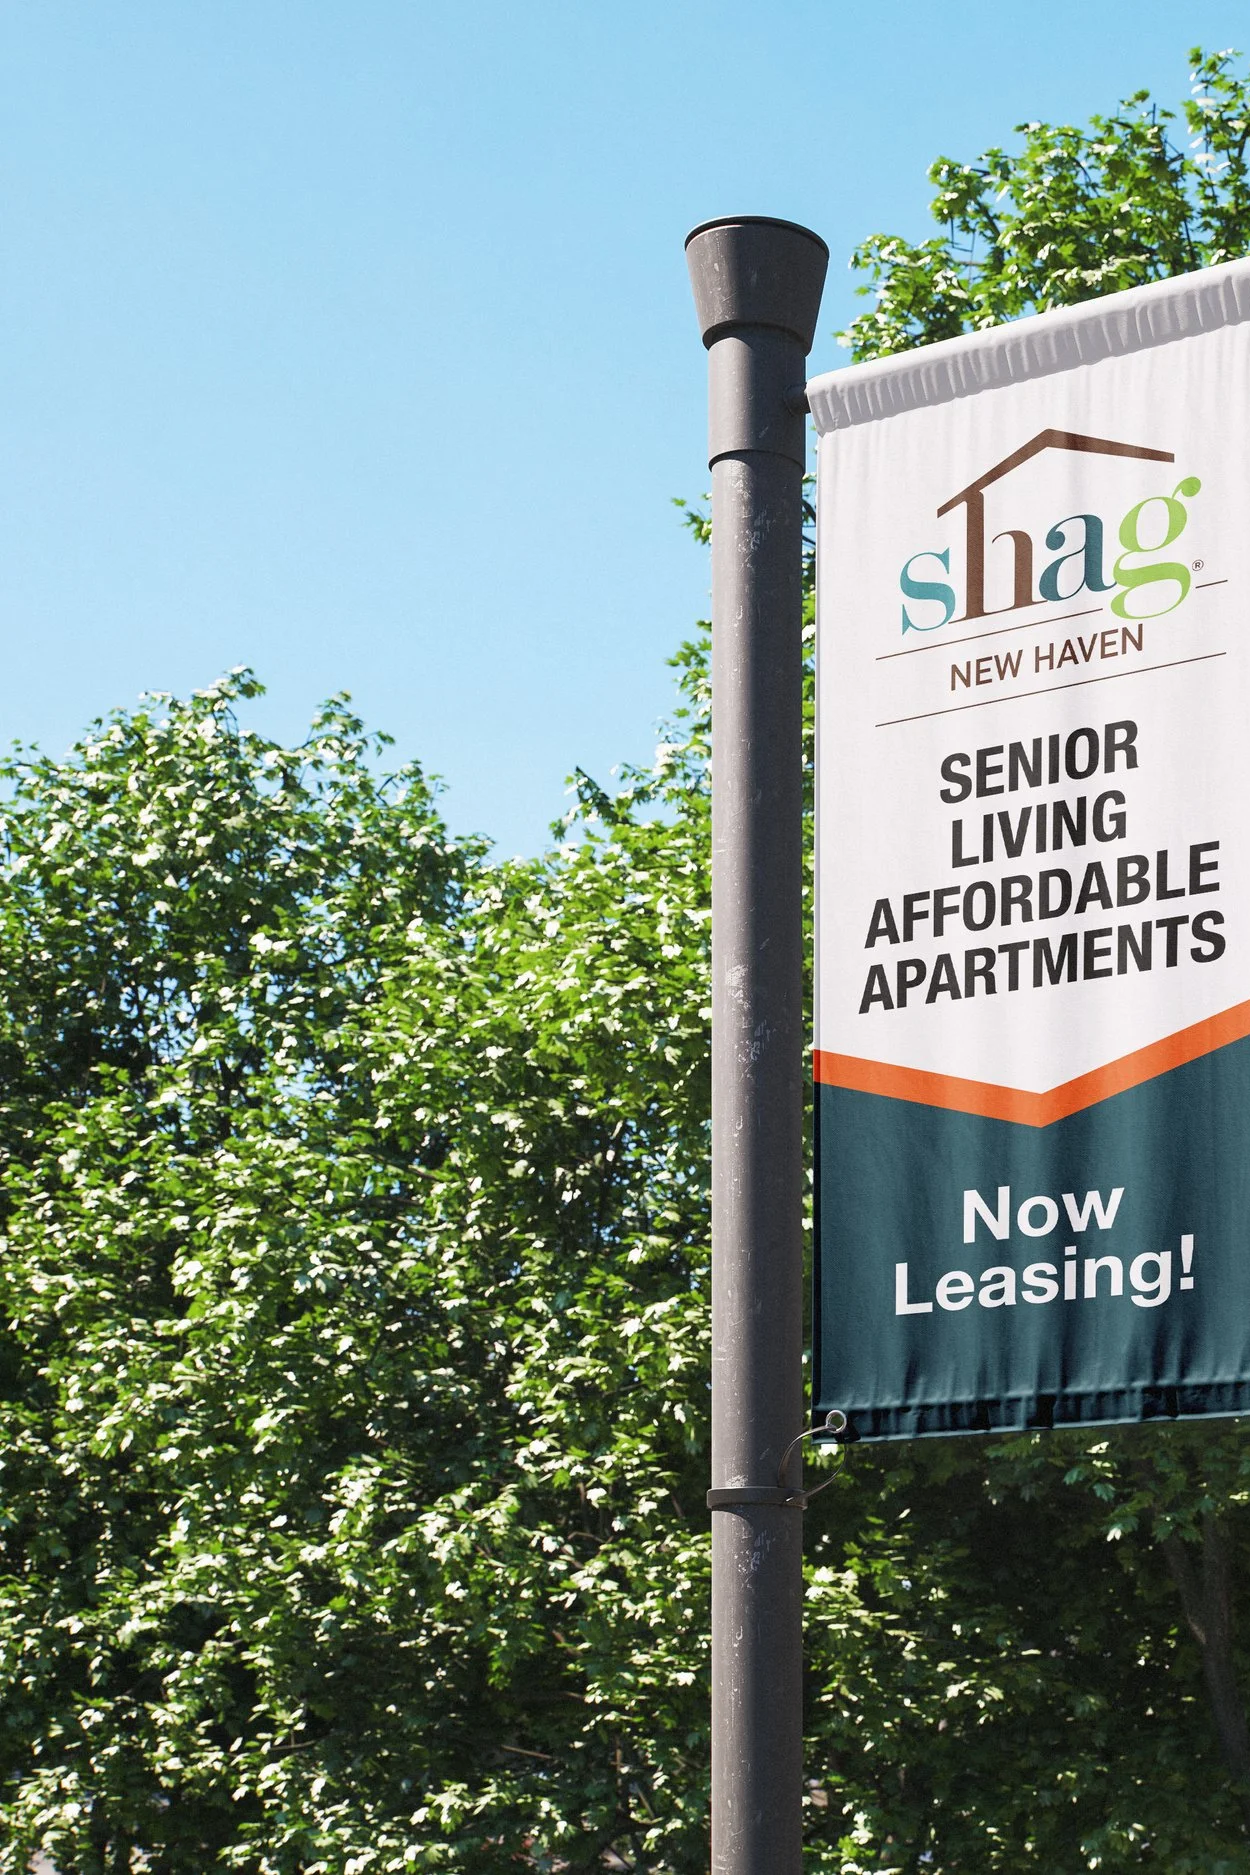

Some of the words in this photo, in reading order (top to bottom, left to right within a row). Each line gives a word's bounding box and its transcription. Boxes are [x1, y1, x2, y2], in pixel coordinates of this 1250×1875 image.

[950, 649, 1023, 691] NEW
[1034, 623, 1143, 674] HAVEN
[939, 719, 1139, 804] SENIOR
[951, 789, 1127, 869] LIVING
[863, 840, 1220, 949] AFFORDABLE
[858, 910, 1227, 1015] APARTMENTS
[963, 1185, 1125, 1244] Now
[895, 1234, 1195, 1316] Leasing!
